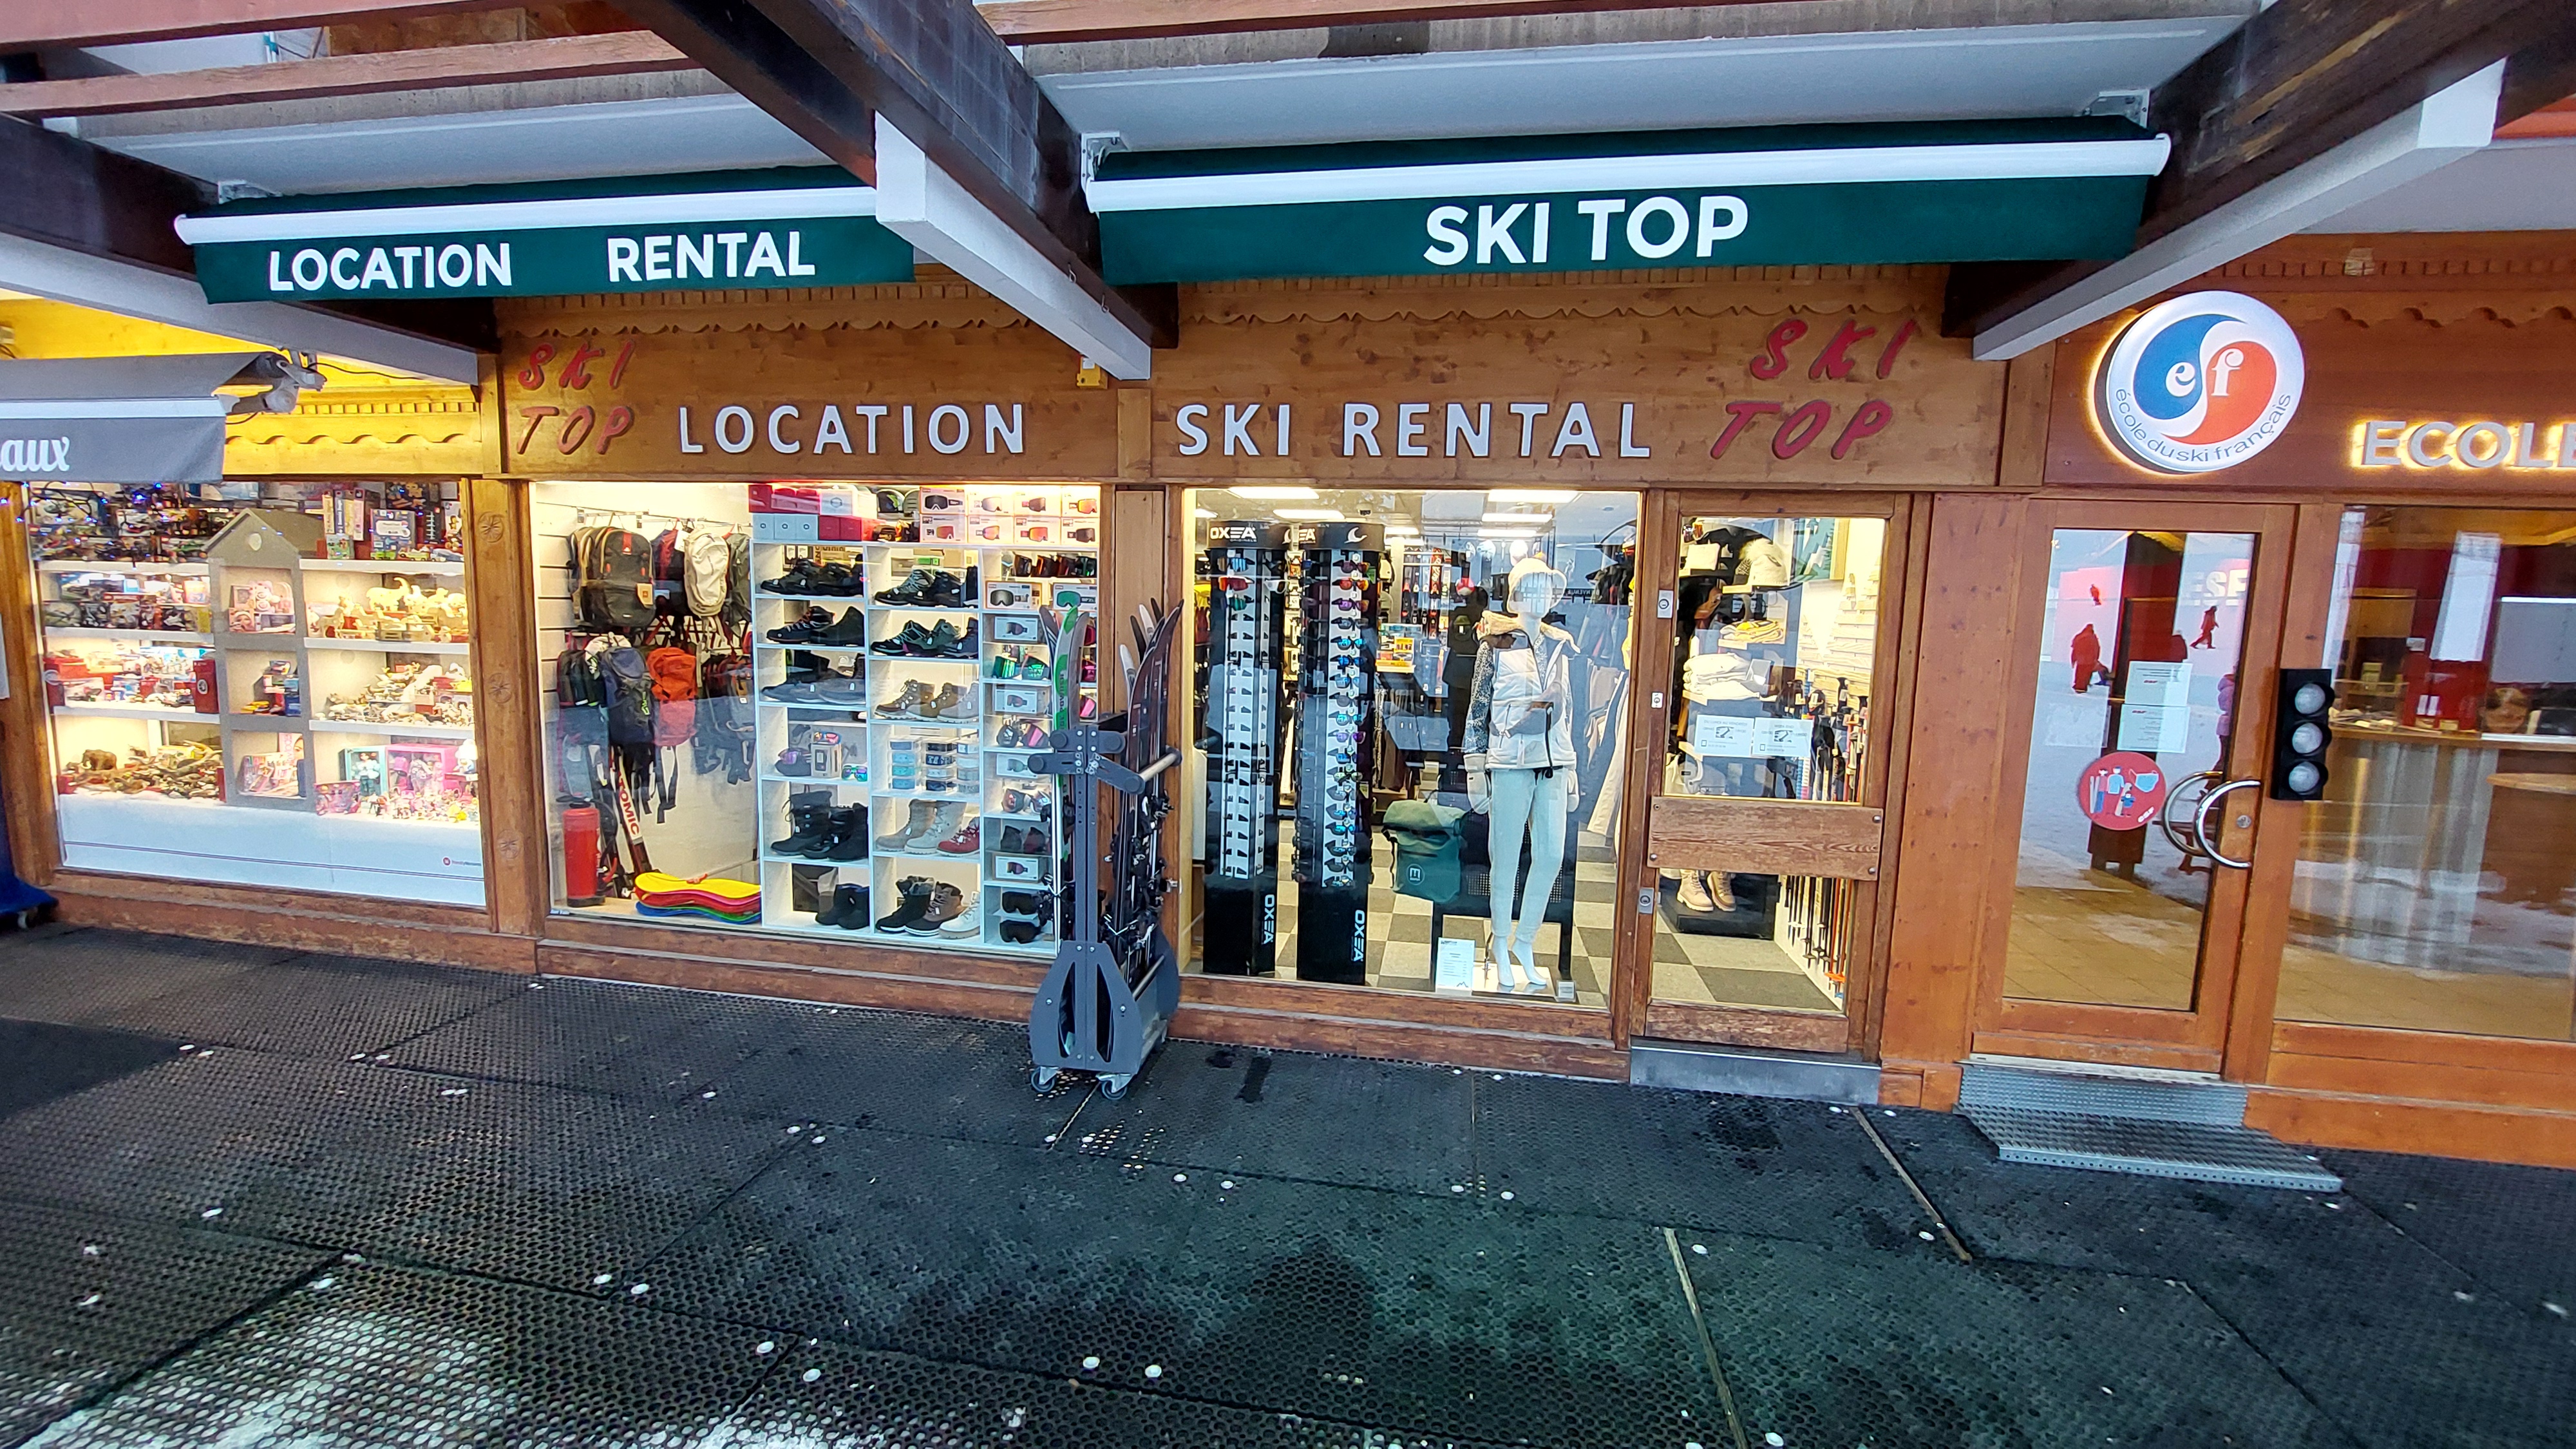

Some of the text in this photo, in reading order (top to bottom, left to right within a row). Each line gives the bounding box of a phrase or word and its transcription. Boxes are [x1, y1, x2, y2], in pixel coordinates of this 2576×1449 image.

[1423, 195, 1748, 267] SKI TOP
[269, 231, 816, 291] LOCATION RENTAL
[517, 339, 635, 390] SKI
[1750, 319, 1920, 380] SKI
[516, 405, 634, 457] TOP
[679, 404, 1025, 455] LOCATION
[1176, 402, 1651, 458] SKI RENTAL
[1710, 399, 1894, 460] TOP
[2213, 393, 2291, 460] français
[0, 436, 70, 472] aux
[1209, 526, 1257, 540] OXEA
[1298, 528, 1316, 542] EA
[1263, 894, 1274, 944] OXEA
[1354, 909, 1365, 961] OXEA
